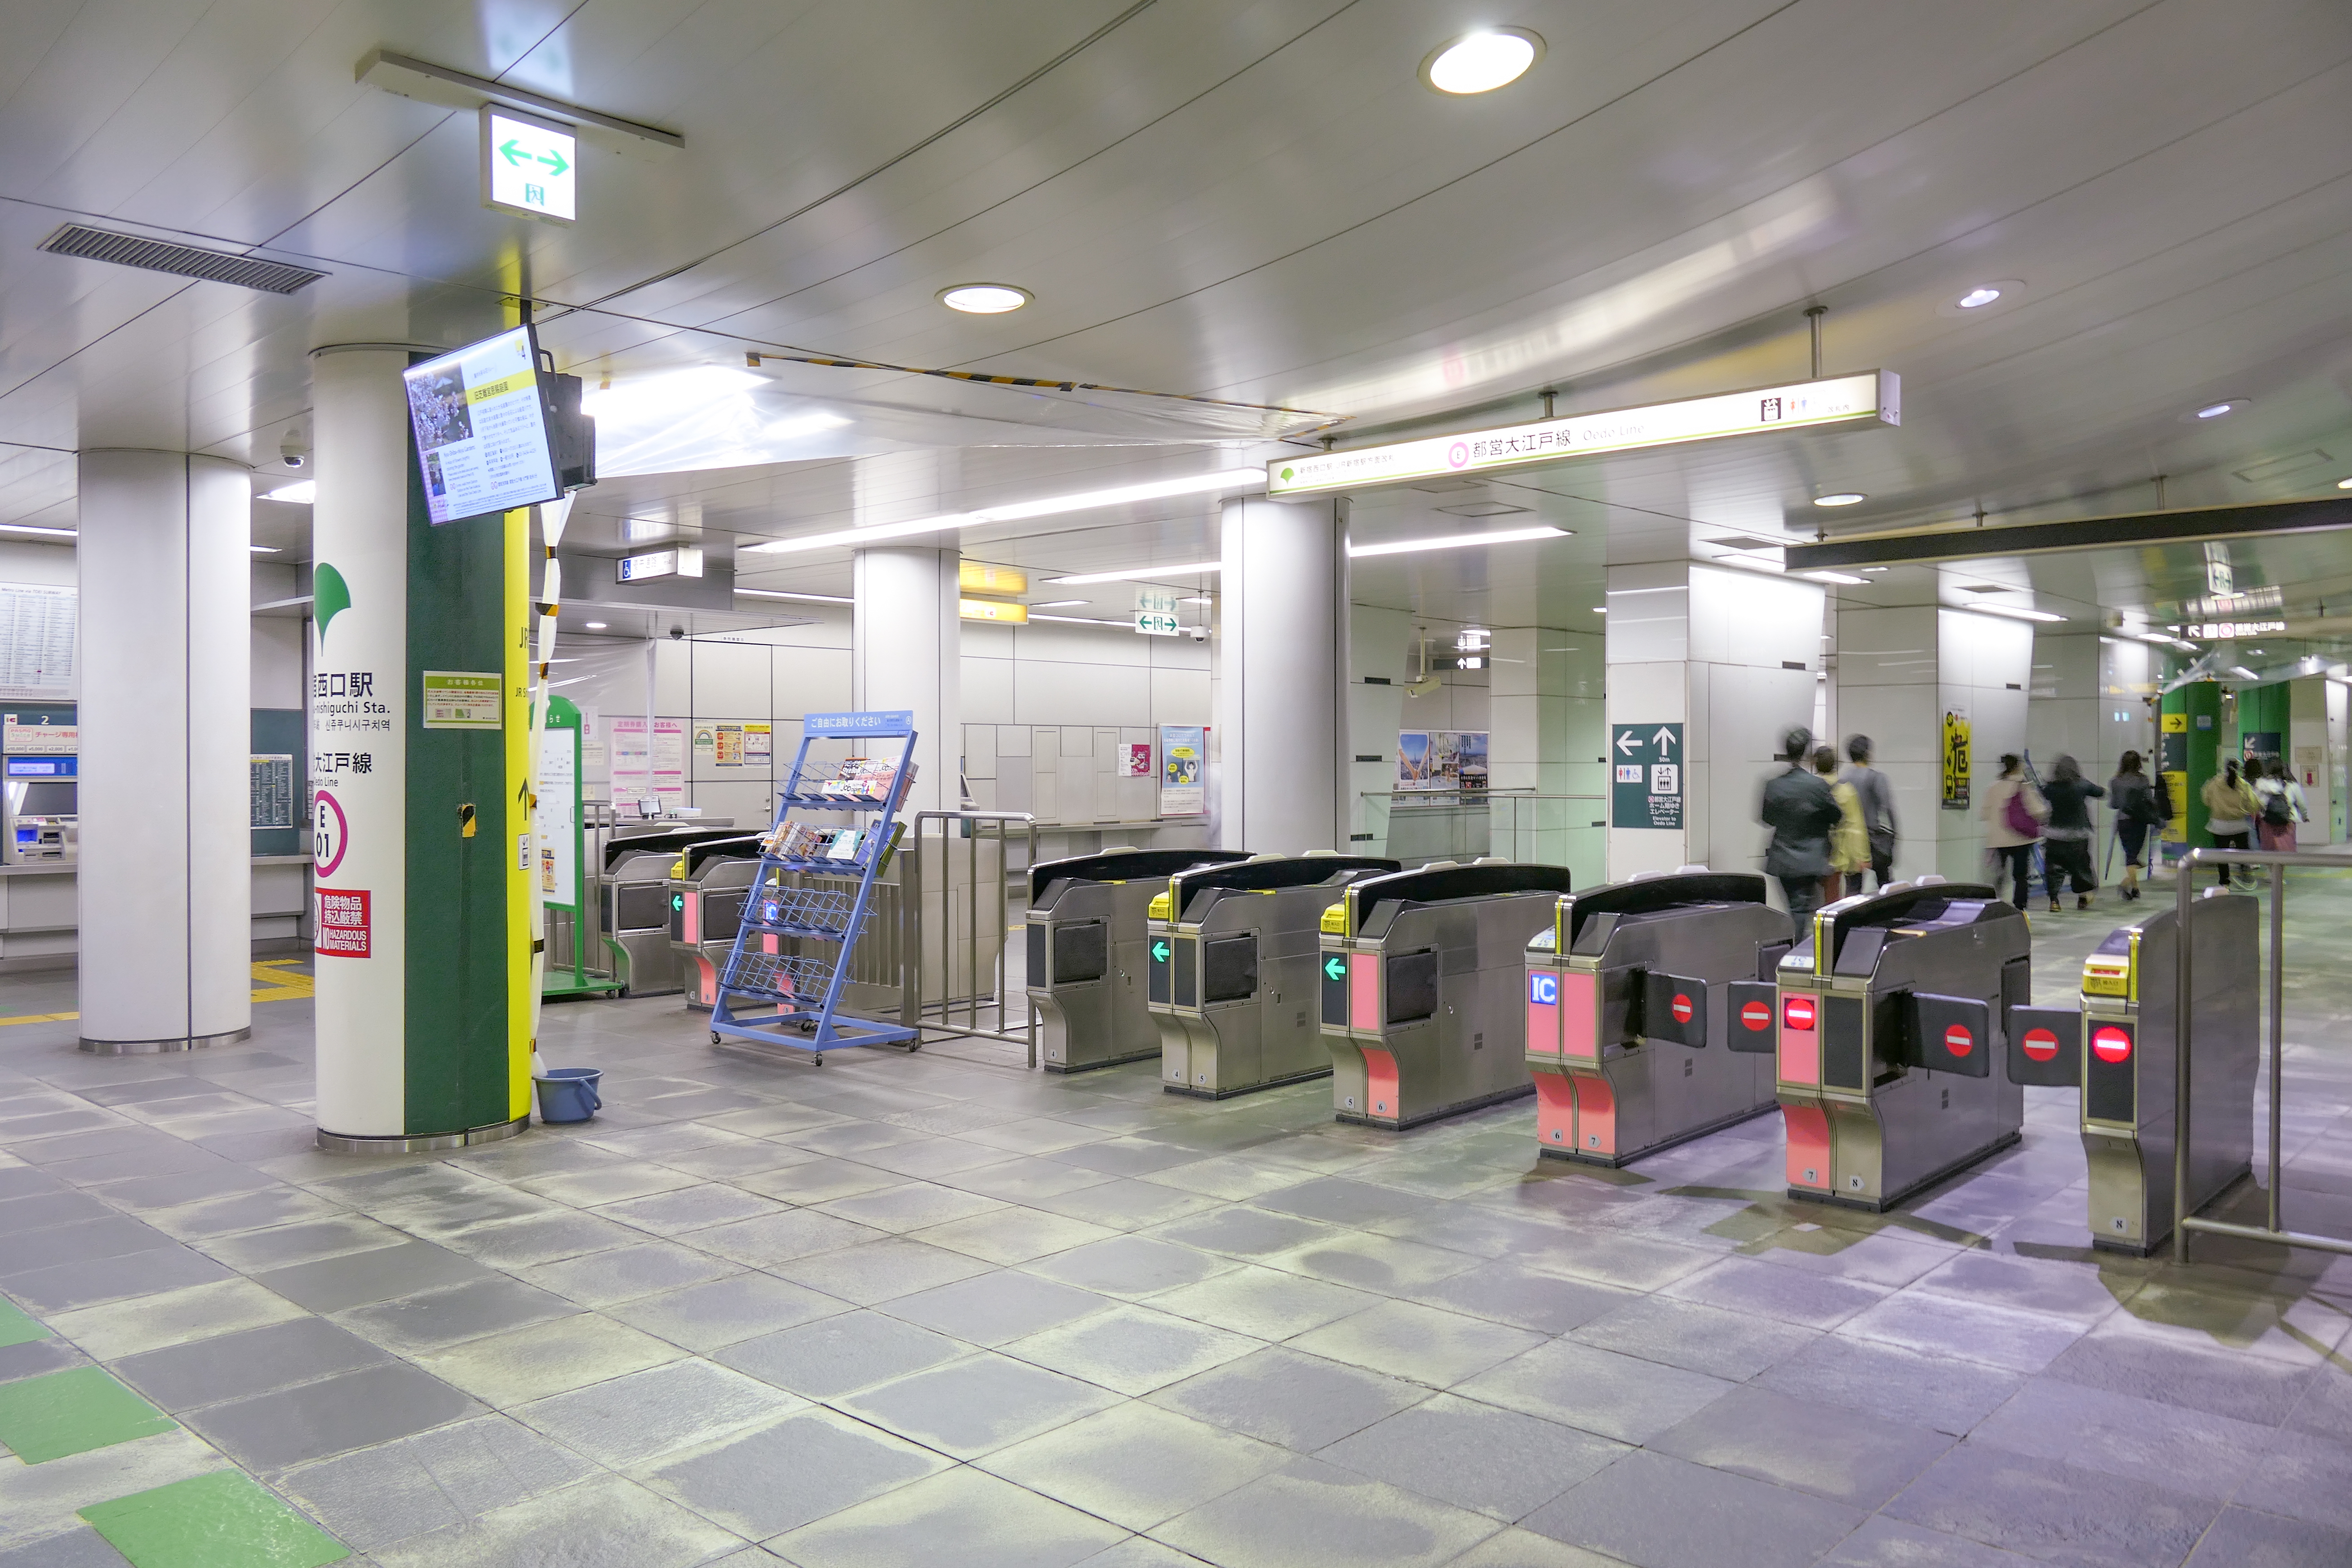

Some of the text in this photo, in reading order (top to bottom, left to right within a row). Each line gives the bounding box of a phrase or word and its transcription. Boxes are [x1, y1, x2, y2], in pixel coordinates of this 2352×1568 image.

[1584, 425, 1644, 440] Oedo Line
[1473, 429, 1571, 458] 都営大江戸線
[1300, 463, 1332, 474] 新宿西口駅
[364, 701, 390, 714] Sta.
[41, 715, 49, 725] 2
[811, 717, 881, 728] ご自由にお取りください
[314, 752, 372, 774] 大江戸線
[324, 777, 338, 787] Line
[320, 805, 325, 828] E
[316, 831, 329, 858] 01
[324, 894, 362, 911] 危険物品
[324, 909, 363, 925] 持込厳禁
[323, 927, 330, 951] NO
[329, 928, 367, 941] HAZARDOUS
[329, 940, 367, 951] MATERIALS
[1532, 976, 1555, 1003] IC
[1809, 1171, 1813, 1179] 7
[1852, 1179, 1858, 1187] 8
[2115, 1219, 2122, 1230] 8
